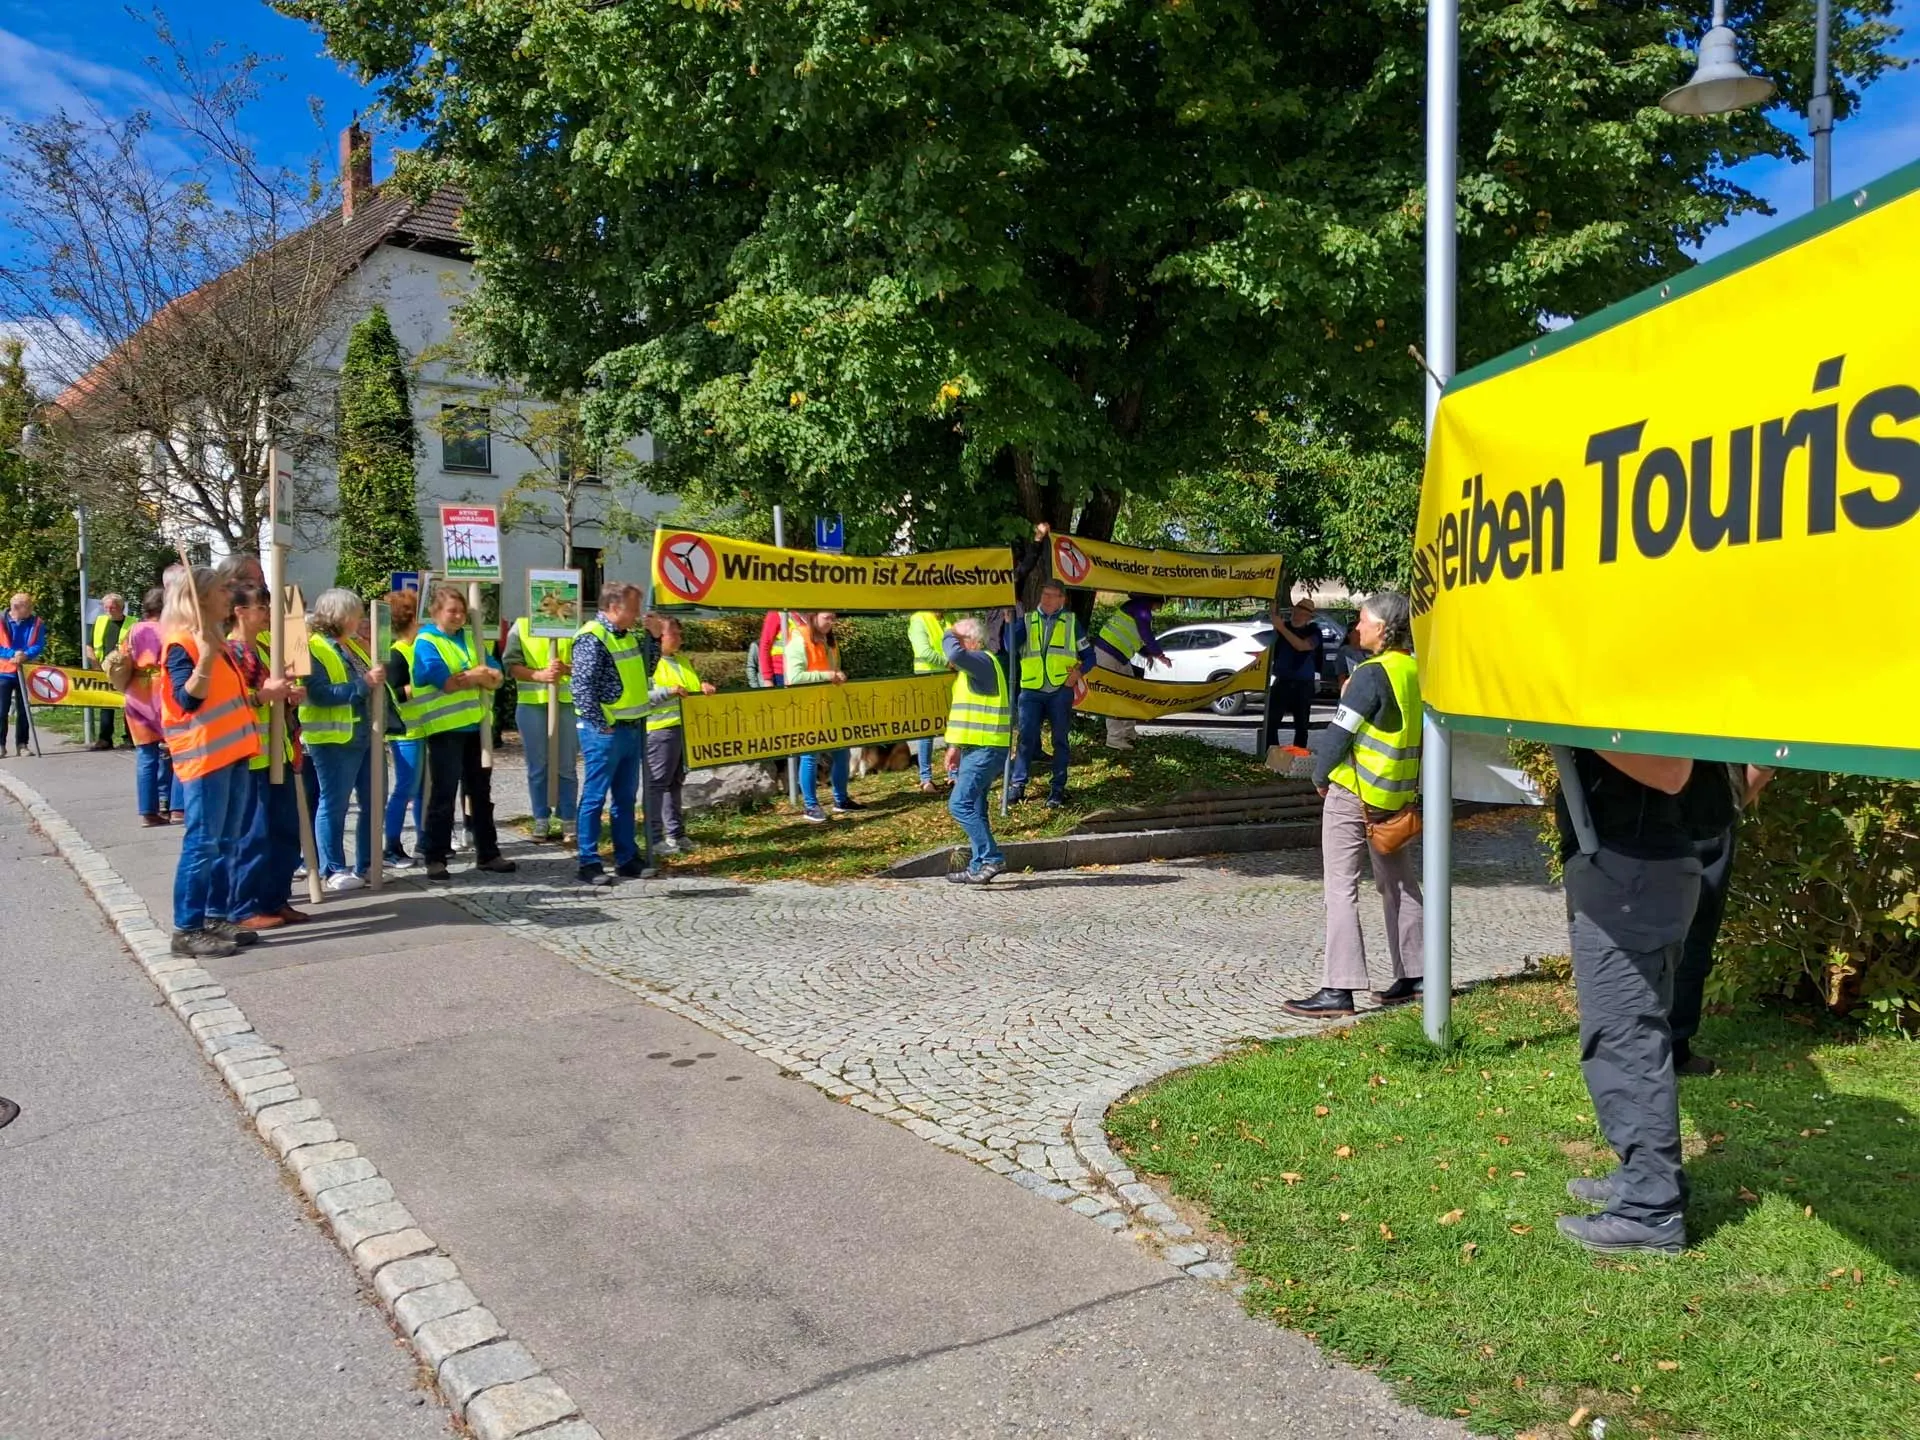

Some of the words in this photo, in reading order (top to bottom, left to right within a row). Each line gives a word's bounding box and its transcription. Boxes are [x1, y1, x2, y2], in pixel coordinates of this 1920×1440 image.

[722, 553, 867, 585] Windstrom
[872, 562, 899, 586] ist
[1152, 564, 1209, 578] zerstören
[1212, 564, 1227, 579] die
[691, 740, 743, 761] UNSER
[747, 728, 838, 754] HAISTERGAU
[841, 722, 888, 741] DREHT
[891, 717, 931, 735] BALD
